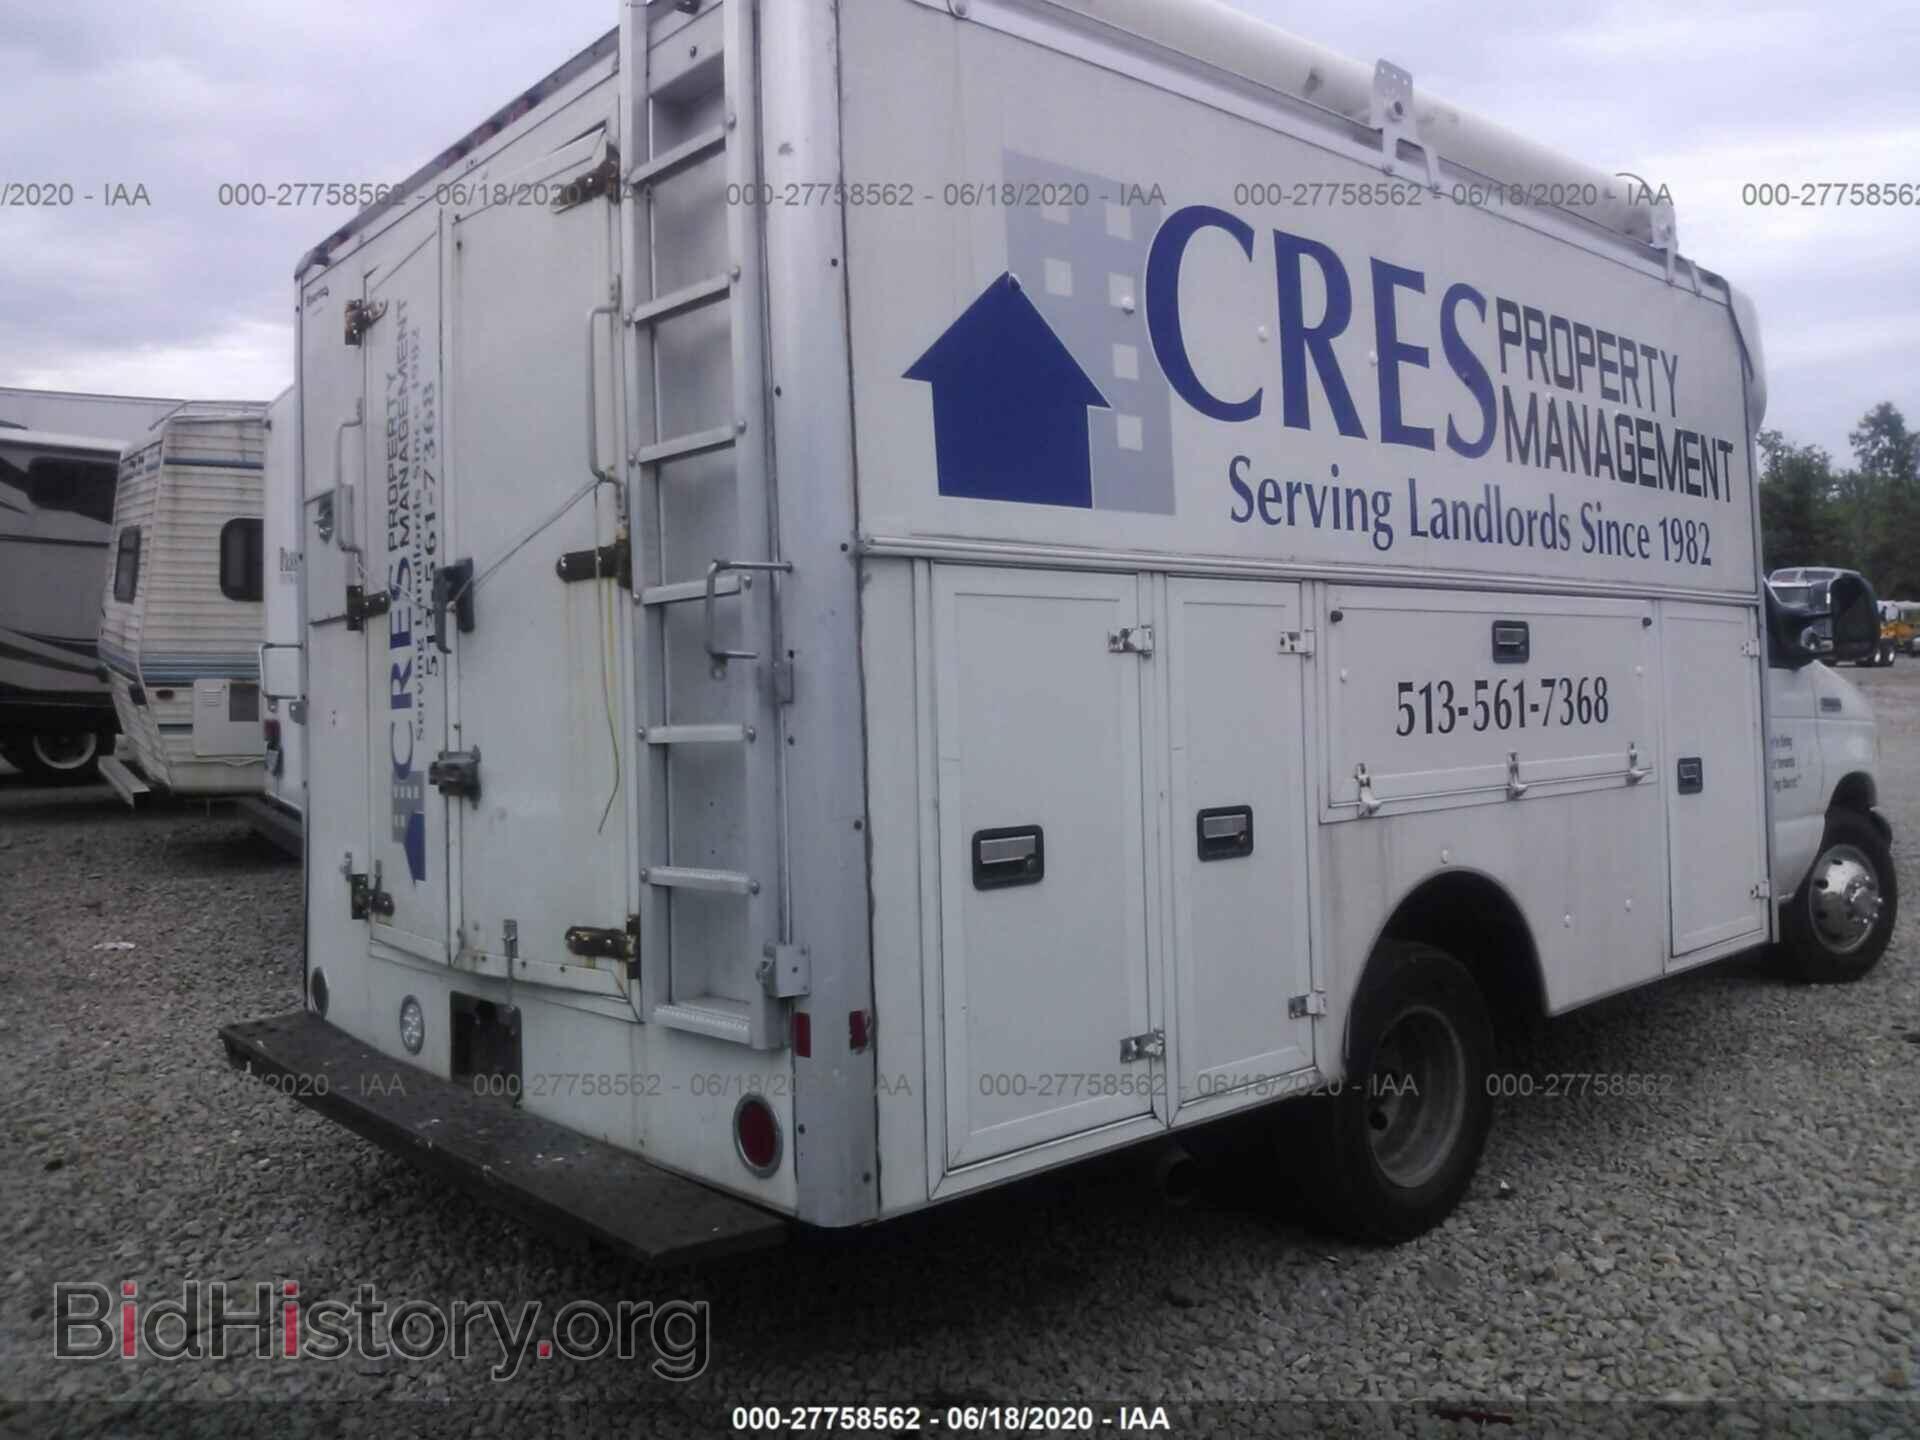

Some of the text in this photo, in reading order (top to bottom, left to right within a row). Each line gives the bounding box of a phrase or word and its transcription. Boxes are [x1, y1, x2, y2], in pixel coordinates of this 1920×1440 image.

[1145, 205, 1498, 459] CRES
[1496, 297, 1678, 418] PROPERTY
[386, 373, 399, 552] PROPERTY
[397, 301, 410, 547] MANAGEMENT
[1502, 386, 1734, 502] MANAGEMENT
[1229, 455, 1712, 566] Serving Landlords Since 1982
[389, 557, 414, 780] CRES
[1396, 676, 1609, 737] 513-561-7368
